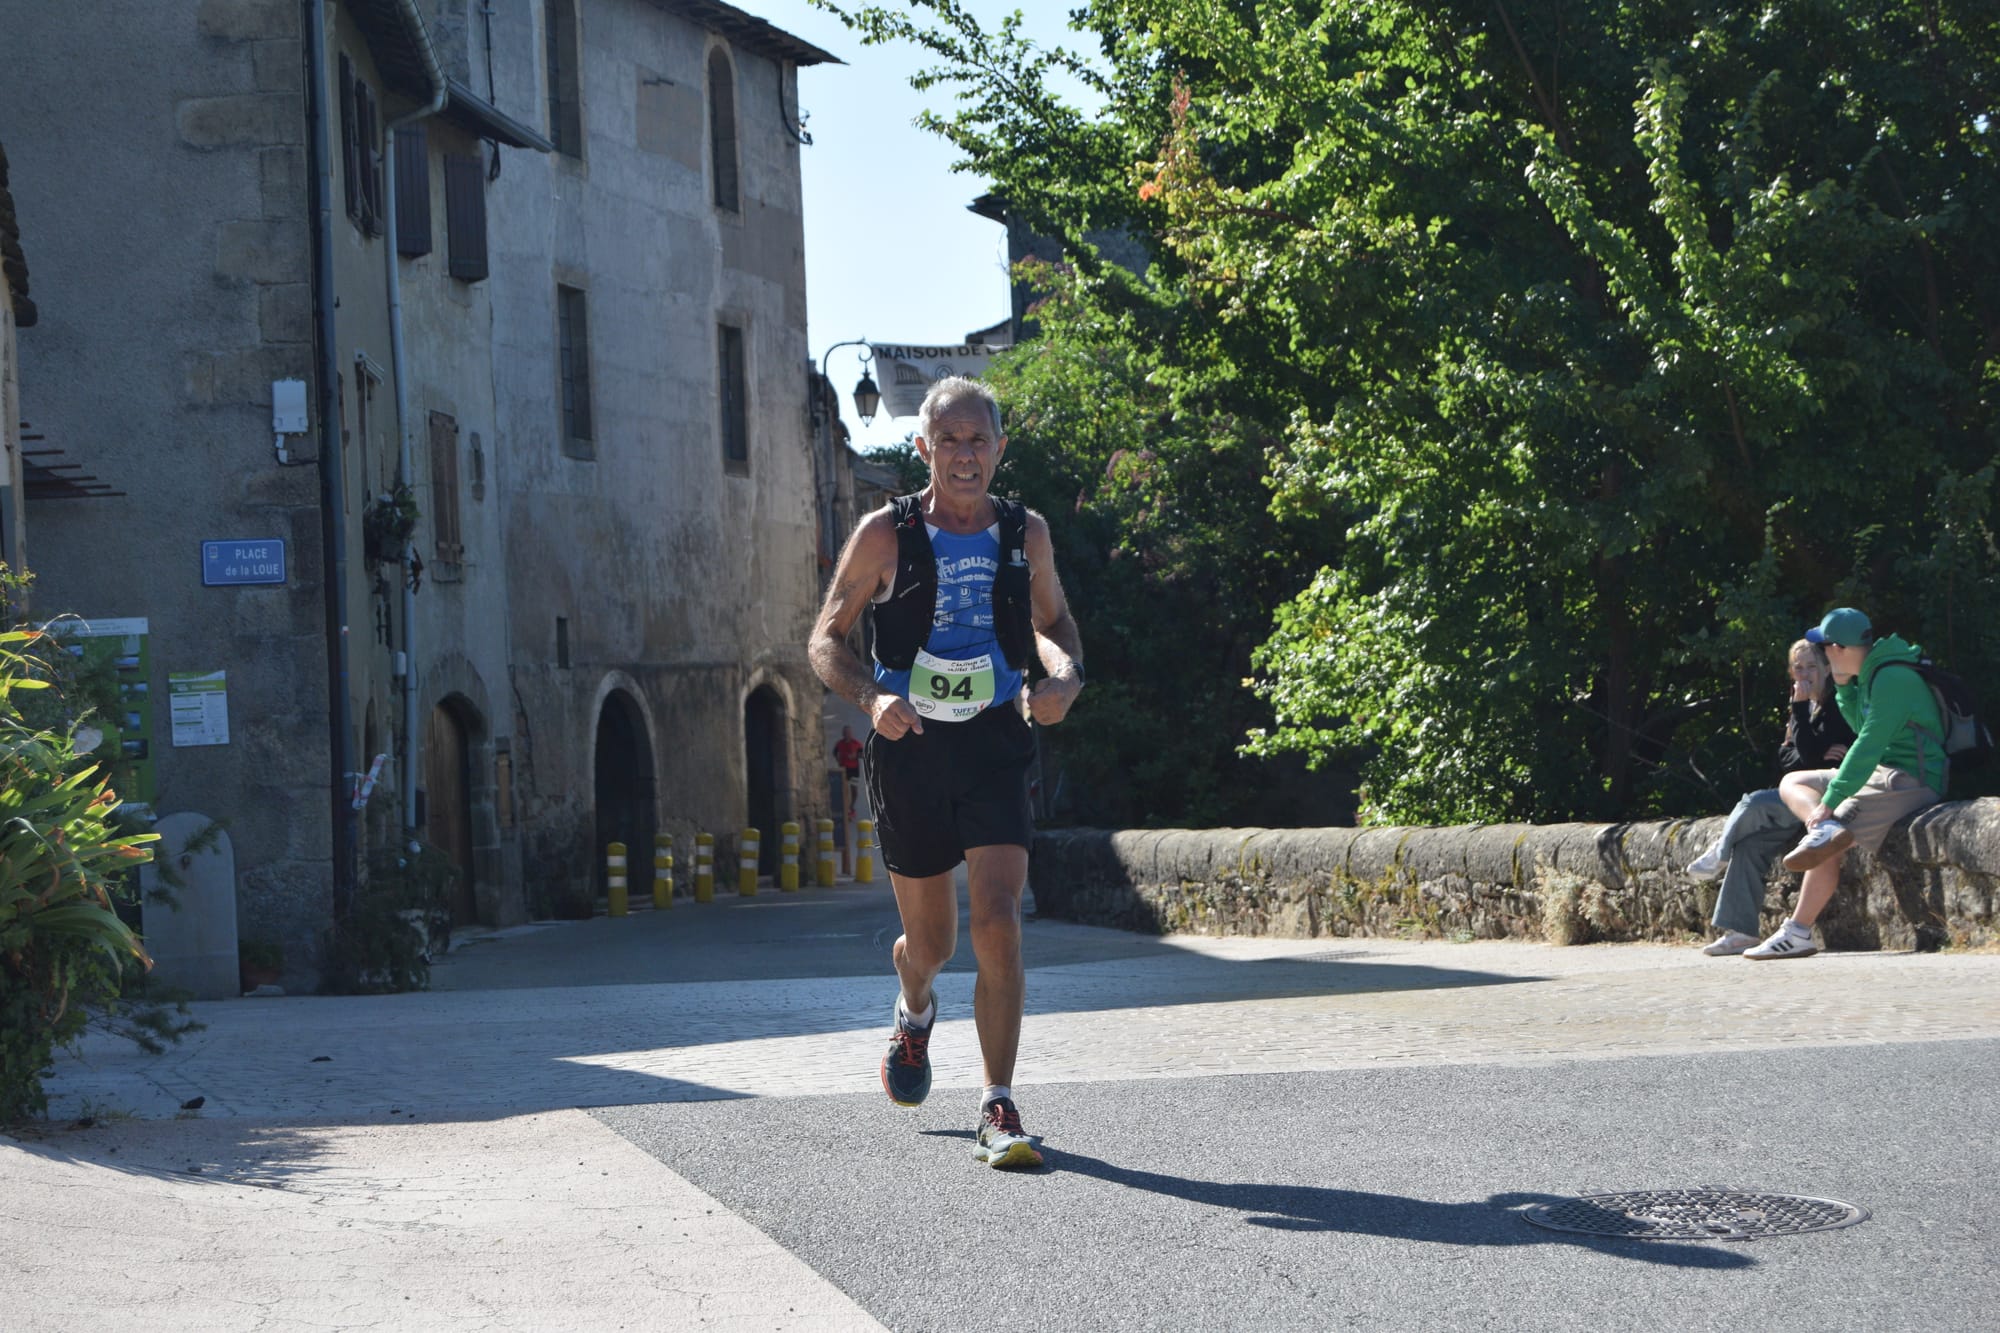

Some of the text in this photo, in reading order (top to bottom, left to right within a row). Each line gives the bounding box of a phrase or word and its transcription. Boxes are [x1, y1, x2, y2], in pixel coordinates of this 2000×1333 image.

[879, 346, 951, 360] MAISON
[958, 346, 981, 356] DE
[235, 548, 268, 560] PLACE
[225, 563, 279, 576] de la LOUE
[930, 675, 973, 700] 94
